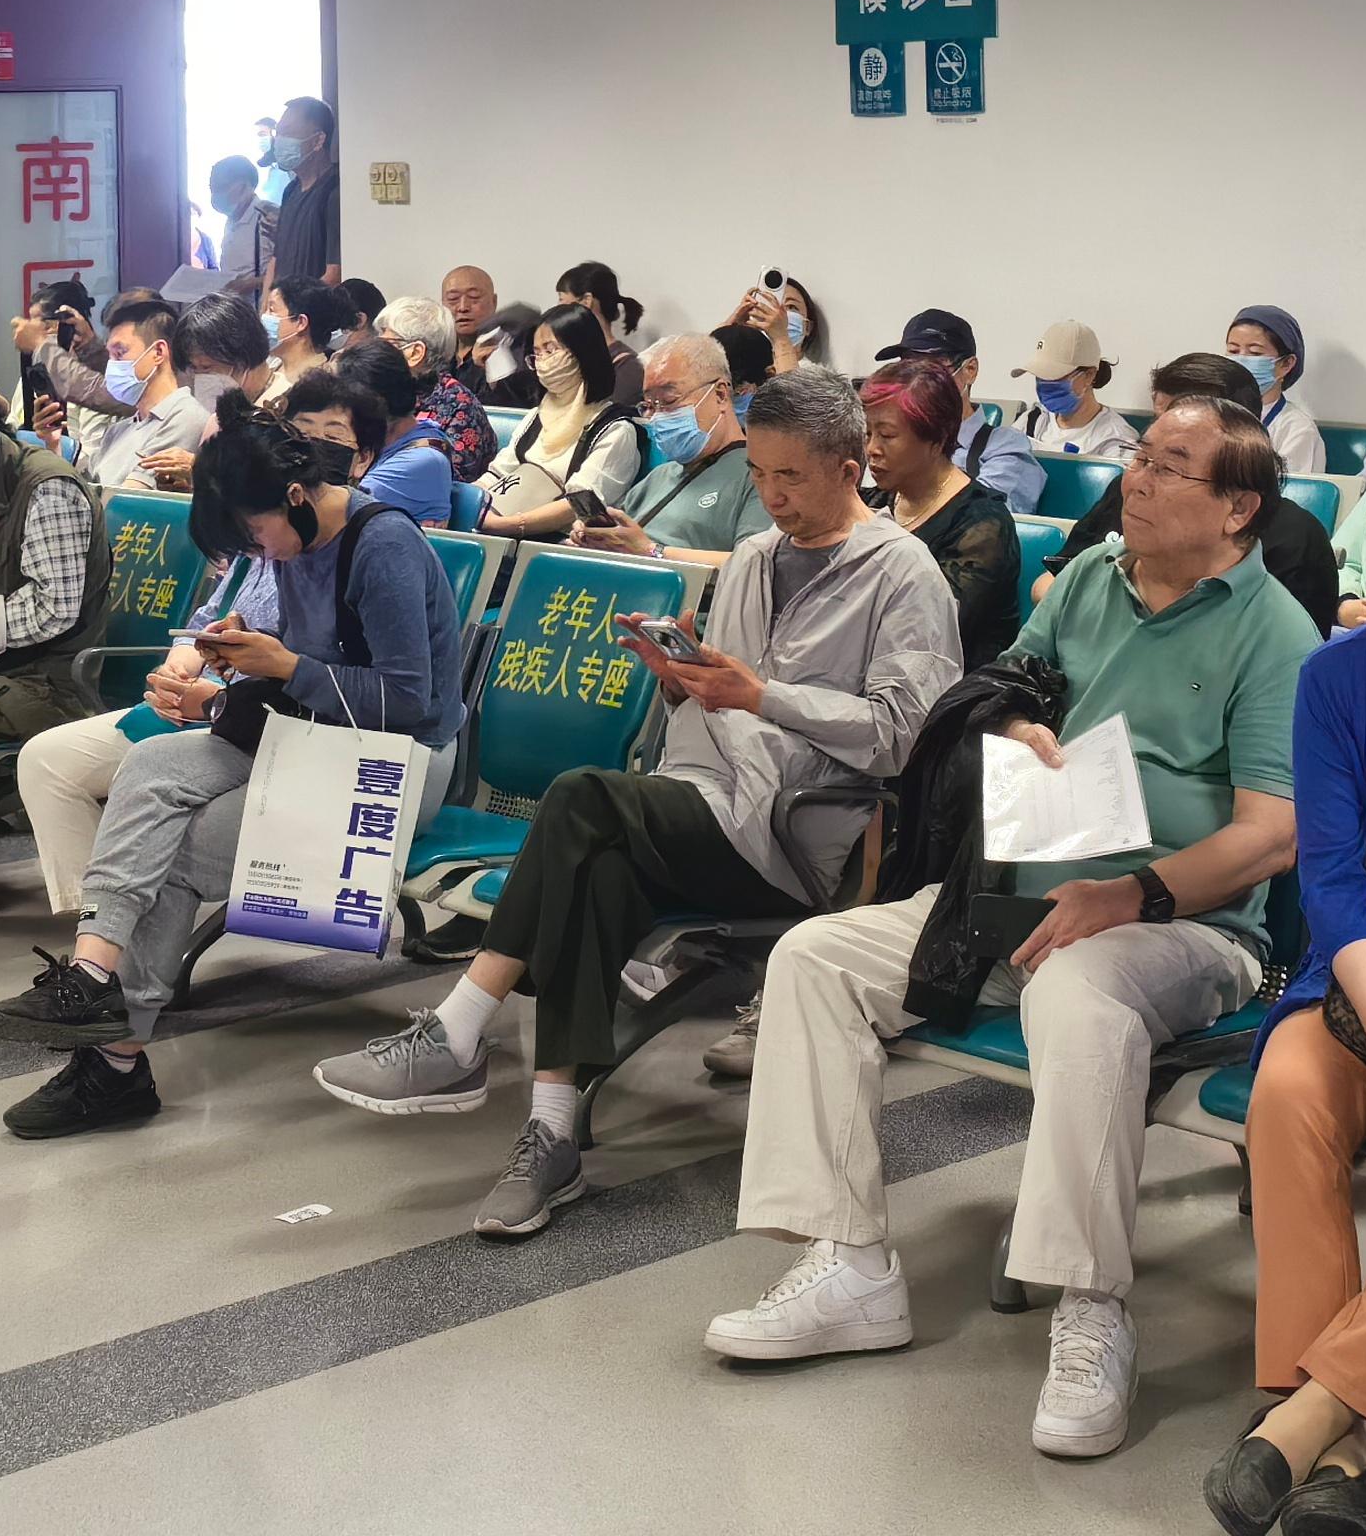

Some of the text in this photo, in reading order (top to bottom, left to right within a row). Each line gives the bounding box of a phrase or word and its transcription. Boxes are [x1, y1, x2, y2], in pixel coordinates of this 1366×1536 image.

[863, 53, 883, 80] 静
[112, 520, 170, 566] 老年人
[108, 568, 178, 619] 人专座
[538, 585, 618, 644] 老年人
[493, 639, 635, 709] 残疾人专座
[333, 758, 405, 929] 壹度广告
